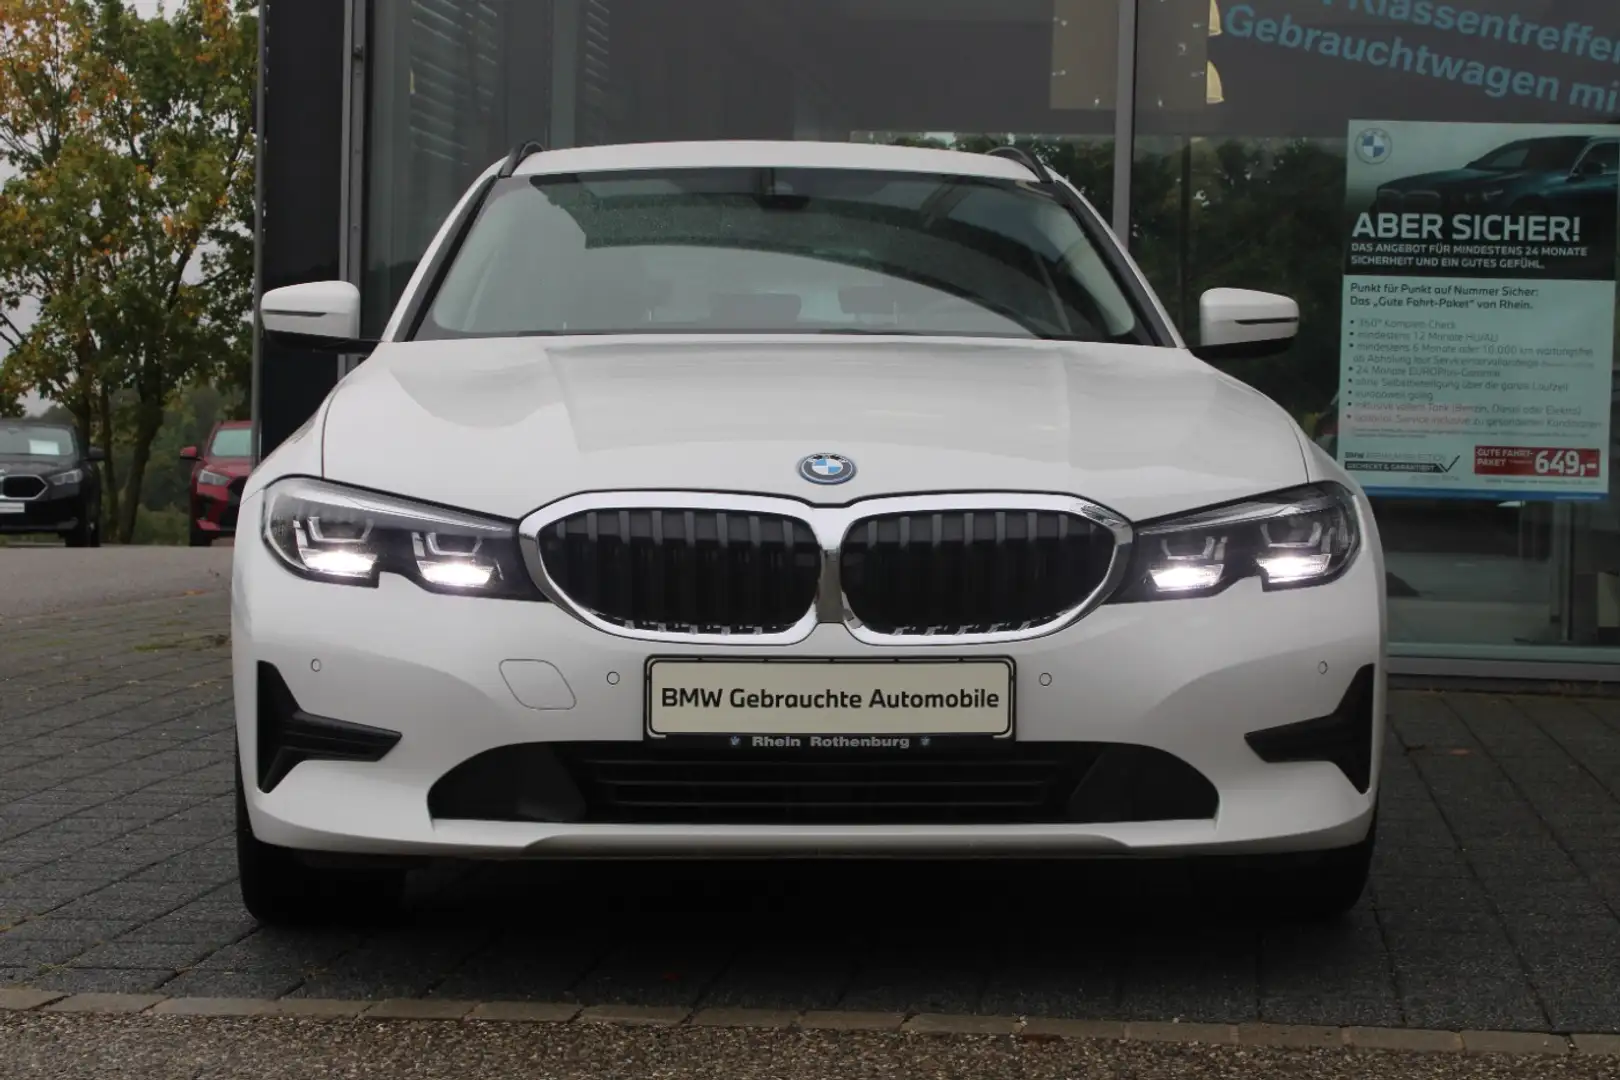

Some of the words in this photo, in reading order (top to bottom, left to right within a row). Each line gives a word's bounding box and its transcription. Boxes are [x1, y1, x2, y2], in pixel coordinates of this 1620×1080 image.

[1225, 4, 1559, 100] Gebrauchtwagen
[1352, 212, 1443, 239] ABER
[1452, 213, 1580, 242] SICHER!
[1351, 243, 1373, 252] DAS
[1375, 243, 1427, 253] ANGEBOT
[1429, 242, 1450, 254] FÜR
[1453, 244, 1523, 256] MINDESTENS
[1525, 246, 1539, 256] 24
[1541, 247, 1588, 257] MONATE
[1351, 255, 1414, 266] SICHERHEIT
[1415, 256, 1438, 266] UND
[1441, 257, 1459, 267] EIN
[1461, 258, 1497, 268] GUTES
[1499, 257, 1546, 269] GEFÜHL.
[1351, 282, 1381, 293] Punkt
[1384, 283, 1399, 293] für
[1401, 284, 1431, 294] Punkt
[1434, 284, 1452, 294] auf
[1454, 285, 1499, 296] Nummer
[1502, 286, 1538, 297] Sicher:
[1351, 296, 1370, 305] Das
[1477, 301, 1496, 309] von
[1500, 299, 1533, 309] Rhein.
[1414, 331, 1425, 341] 12
[1422, 344, 1457, 354] Monate
[1367, 354, 1412, 365] Abholung
[1355, 365, 1369, 374] 24
[1428, 403, 1449, 412] Tank
[1477, 447, 1500, 456] GUTE
[1477, 458, 1506, 466] PAKET
[662, 688, 722, 707] BMW
[730, 688, 862, 708] Gebrauchte
[869, 688, 999, 708] Automobile
[752, 736, 801, 747] Rhein
[810, 736, 910, 749] Rothenburg
